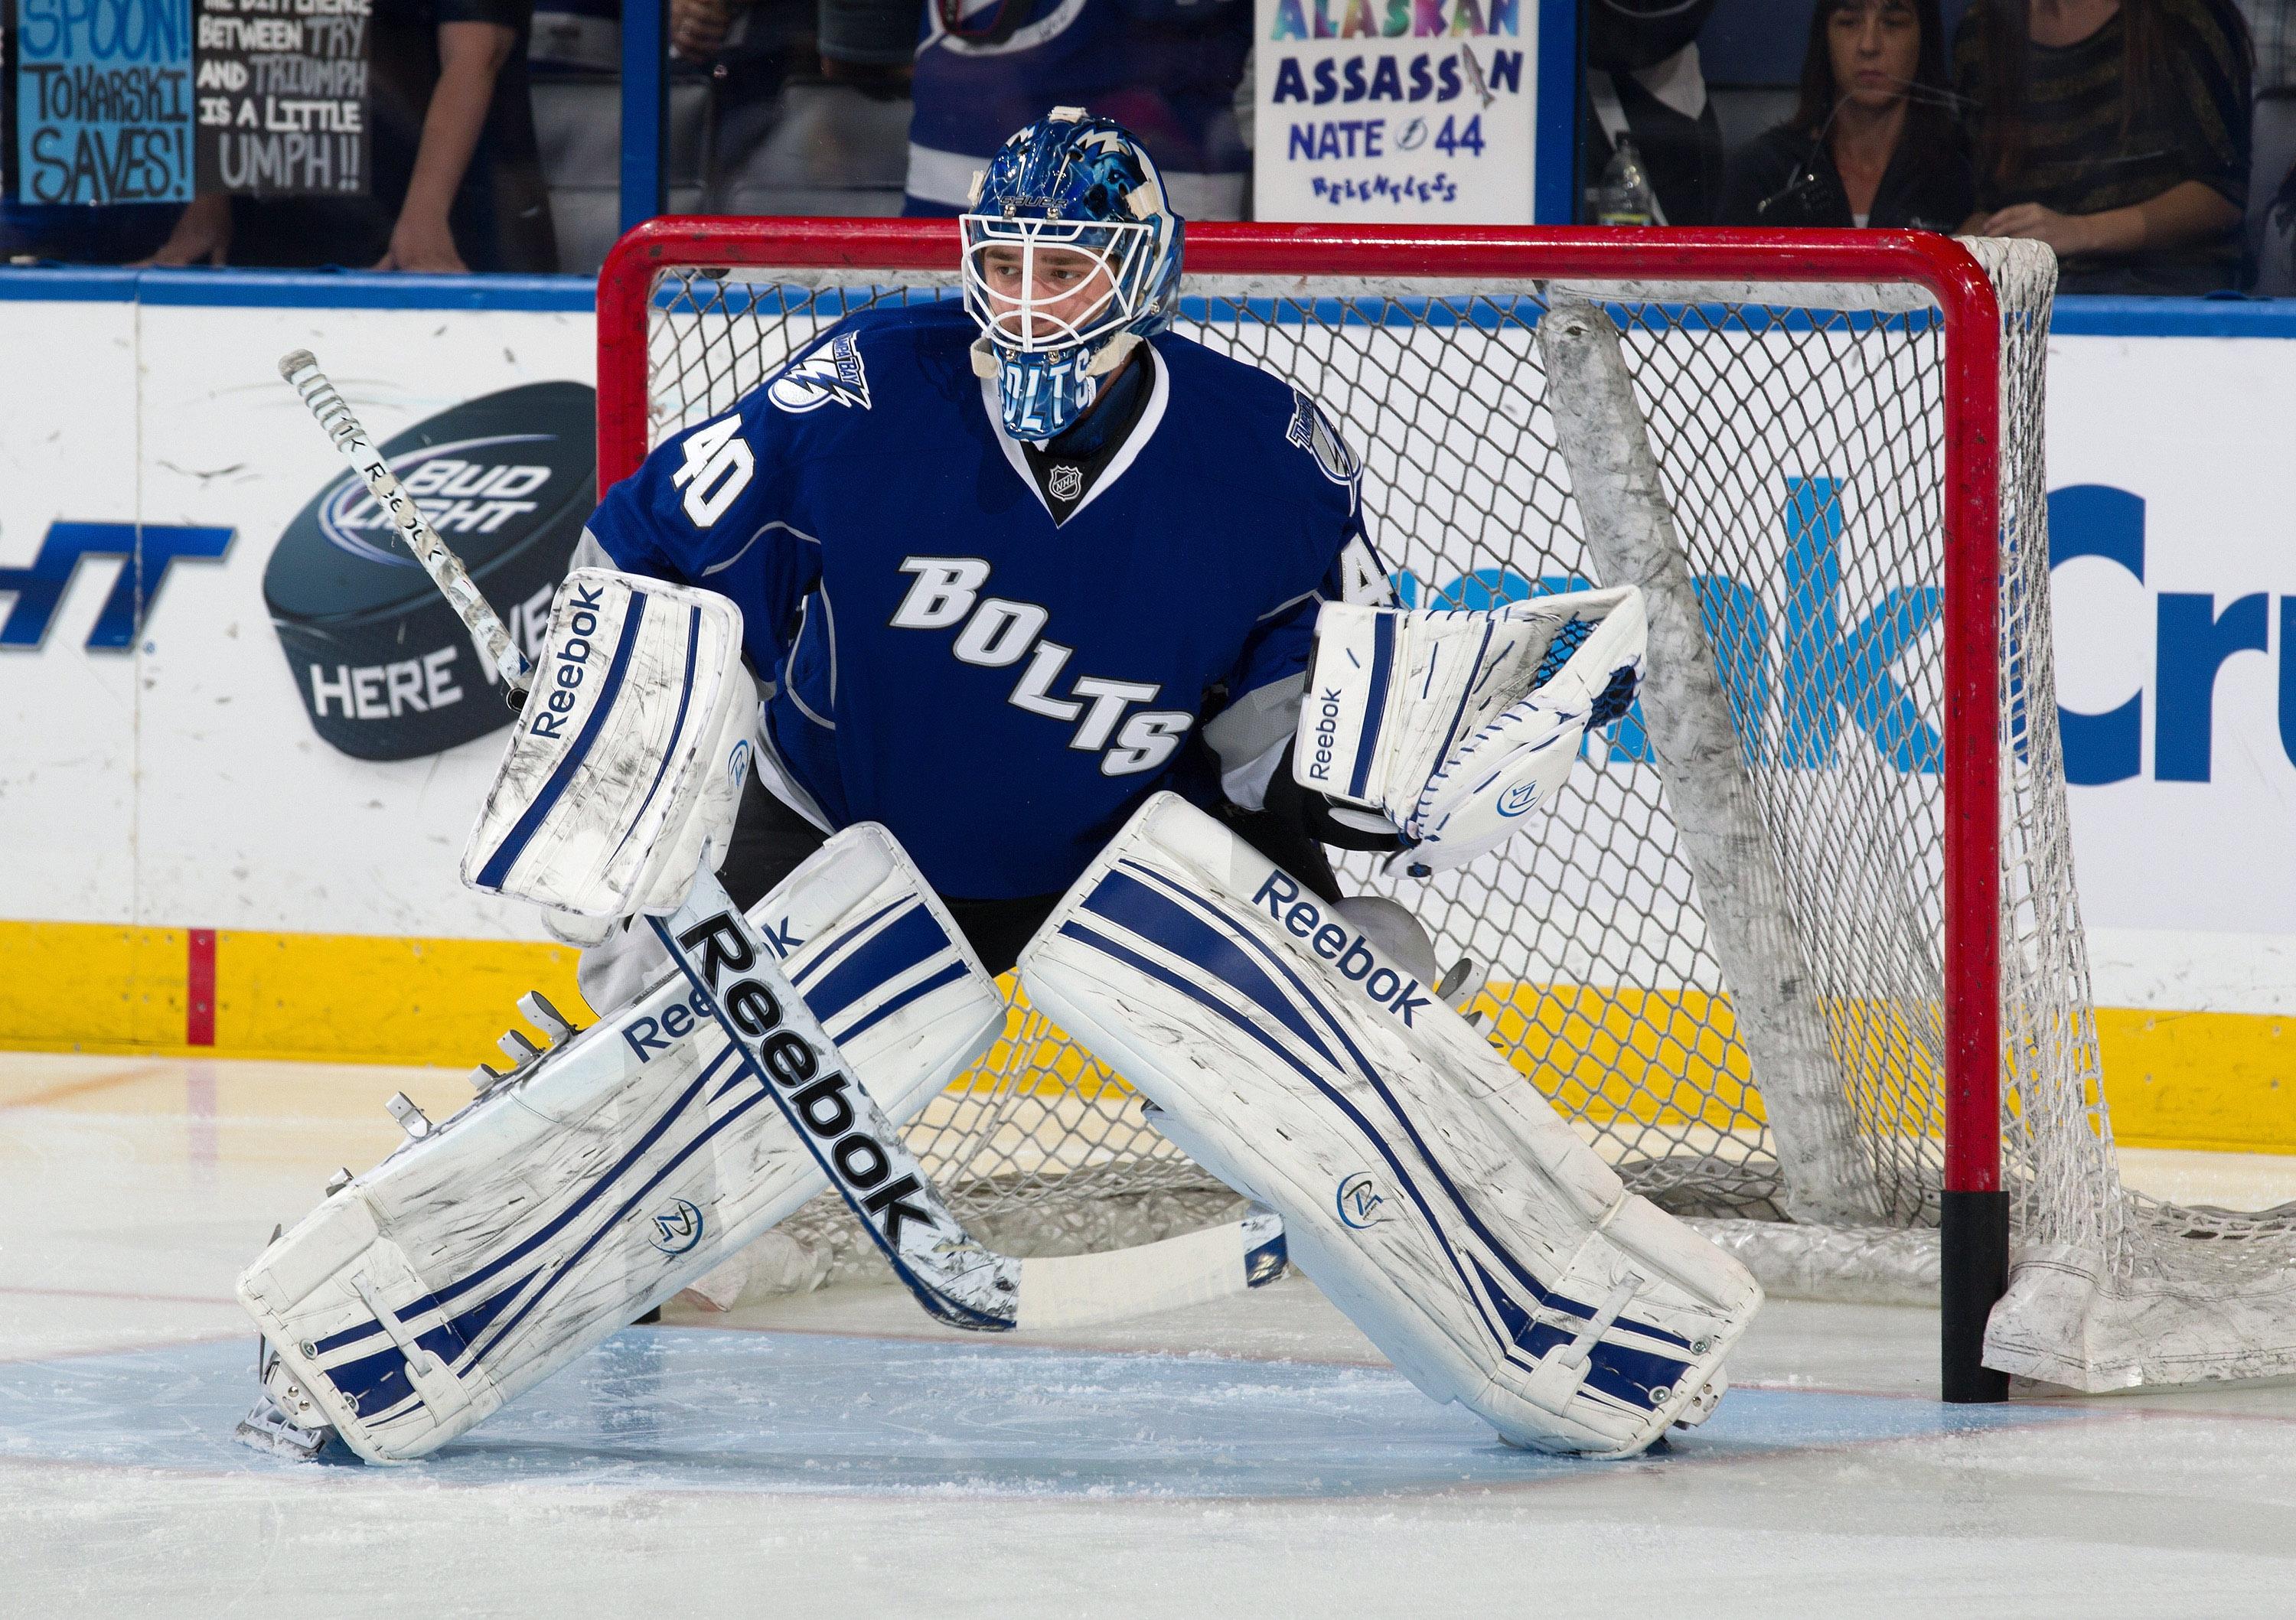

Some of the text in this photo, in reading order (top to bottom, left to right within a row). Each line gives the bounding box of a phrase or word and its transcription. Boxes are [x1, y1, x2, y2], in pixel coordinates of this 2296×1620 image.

[19, 0, 190, 62] SPOON!
[198, 15, 367, 58] BETWEEN TRY
[1270, 0, 1520, 41] ALASKAN
[21, 62, 188, 122] TOKARSKI
[196, 54, 369, 97] AND TRIUMPH
[199, 96, 362, 131] IS A LITTLE
[1289, 113, 1486, 160] NATE 44
[31, 127, 188, 203] SAVES!
[406, 460, 552, 497] BUD
[670, 413, 755, 530] 40
[1055, 474, 1076, 492] NHL
[309, 645, 464, 721] HERE
[530, 582, 605, 740] Reebok
[888, 553, 1195, 777] BOLTS
[1309, 687, 1342, 781] Reebok
[1252, 870, 1433, 1030] Reebok
[675, 910, 941, 1256] Reebok
